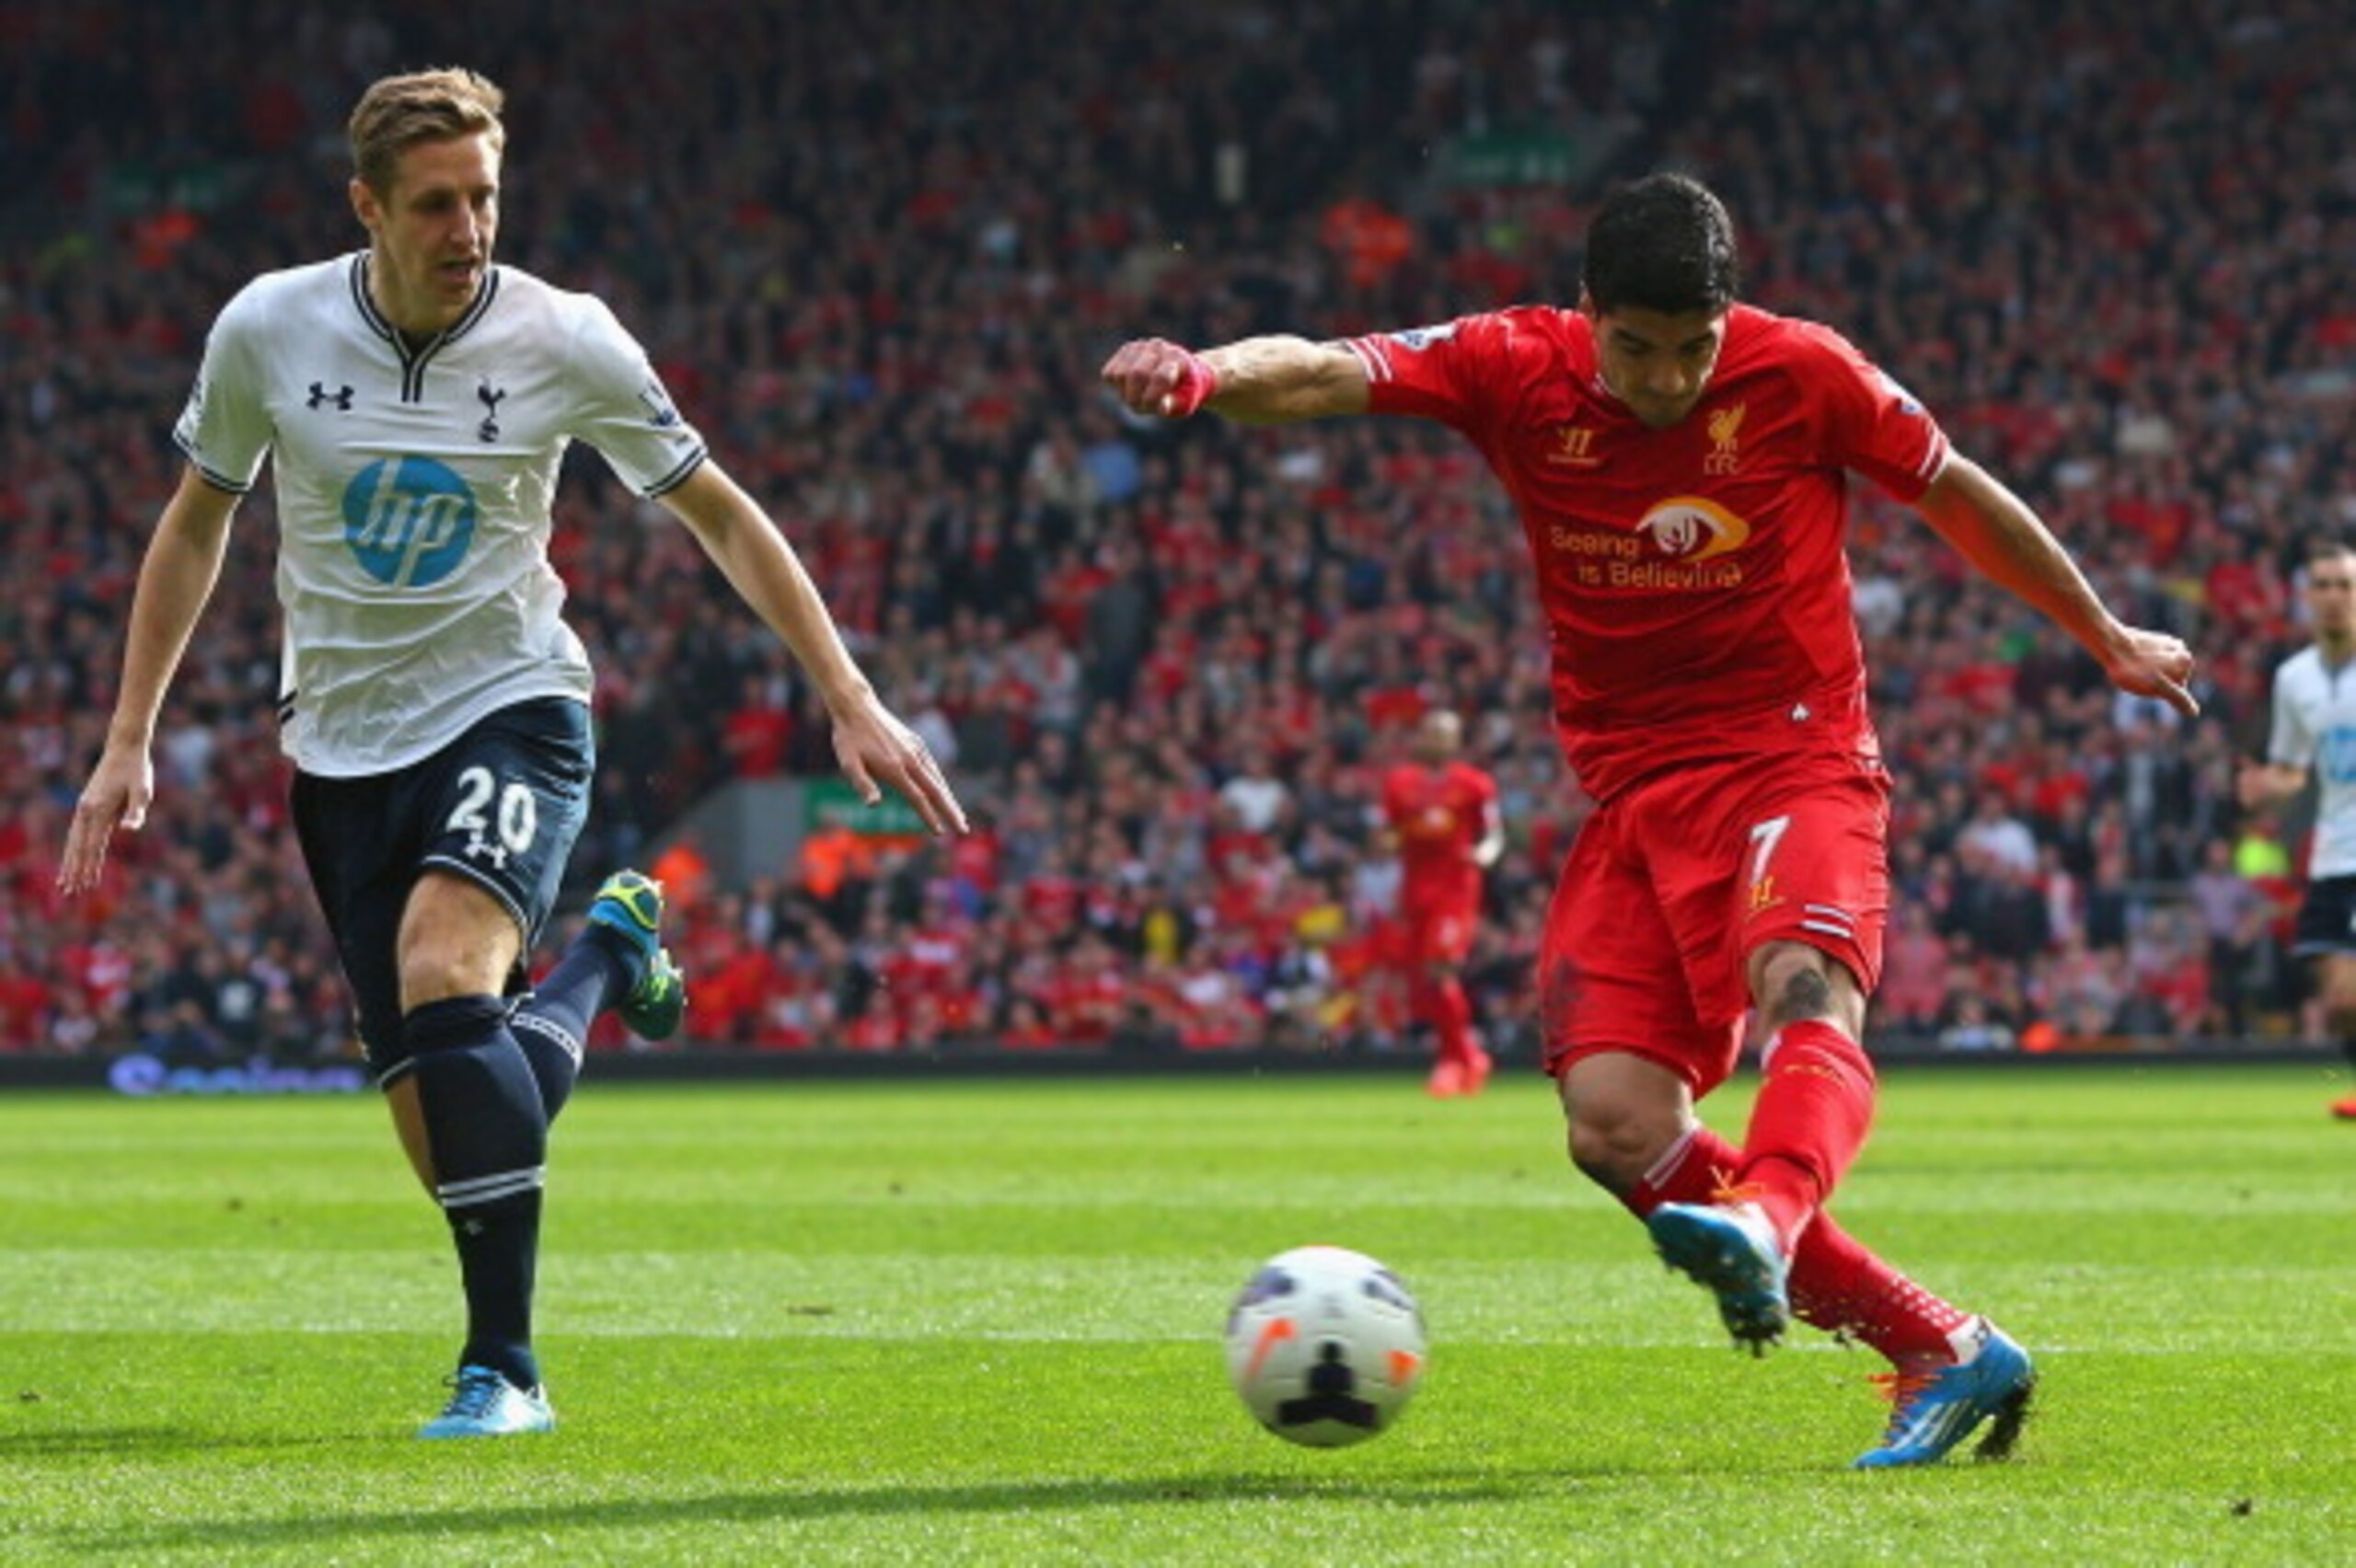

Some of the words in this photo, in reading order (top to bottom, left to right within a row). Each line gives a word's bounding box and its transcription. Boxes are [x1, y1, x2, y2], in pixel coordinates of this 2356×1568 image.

[1703, 453, 1740, 475] LFC
[357, 457, 467, 588] hp
[1551, 525, 1640, 561] Seeing
[1579, 563, 1600, 584] is
[1610, 559, 1742, 588] Believing
[445, 765, 536, 855] 20
[1750, 814, 1790, 886] 7
